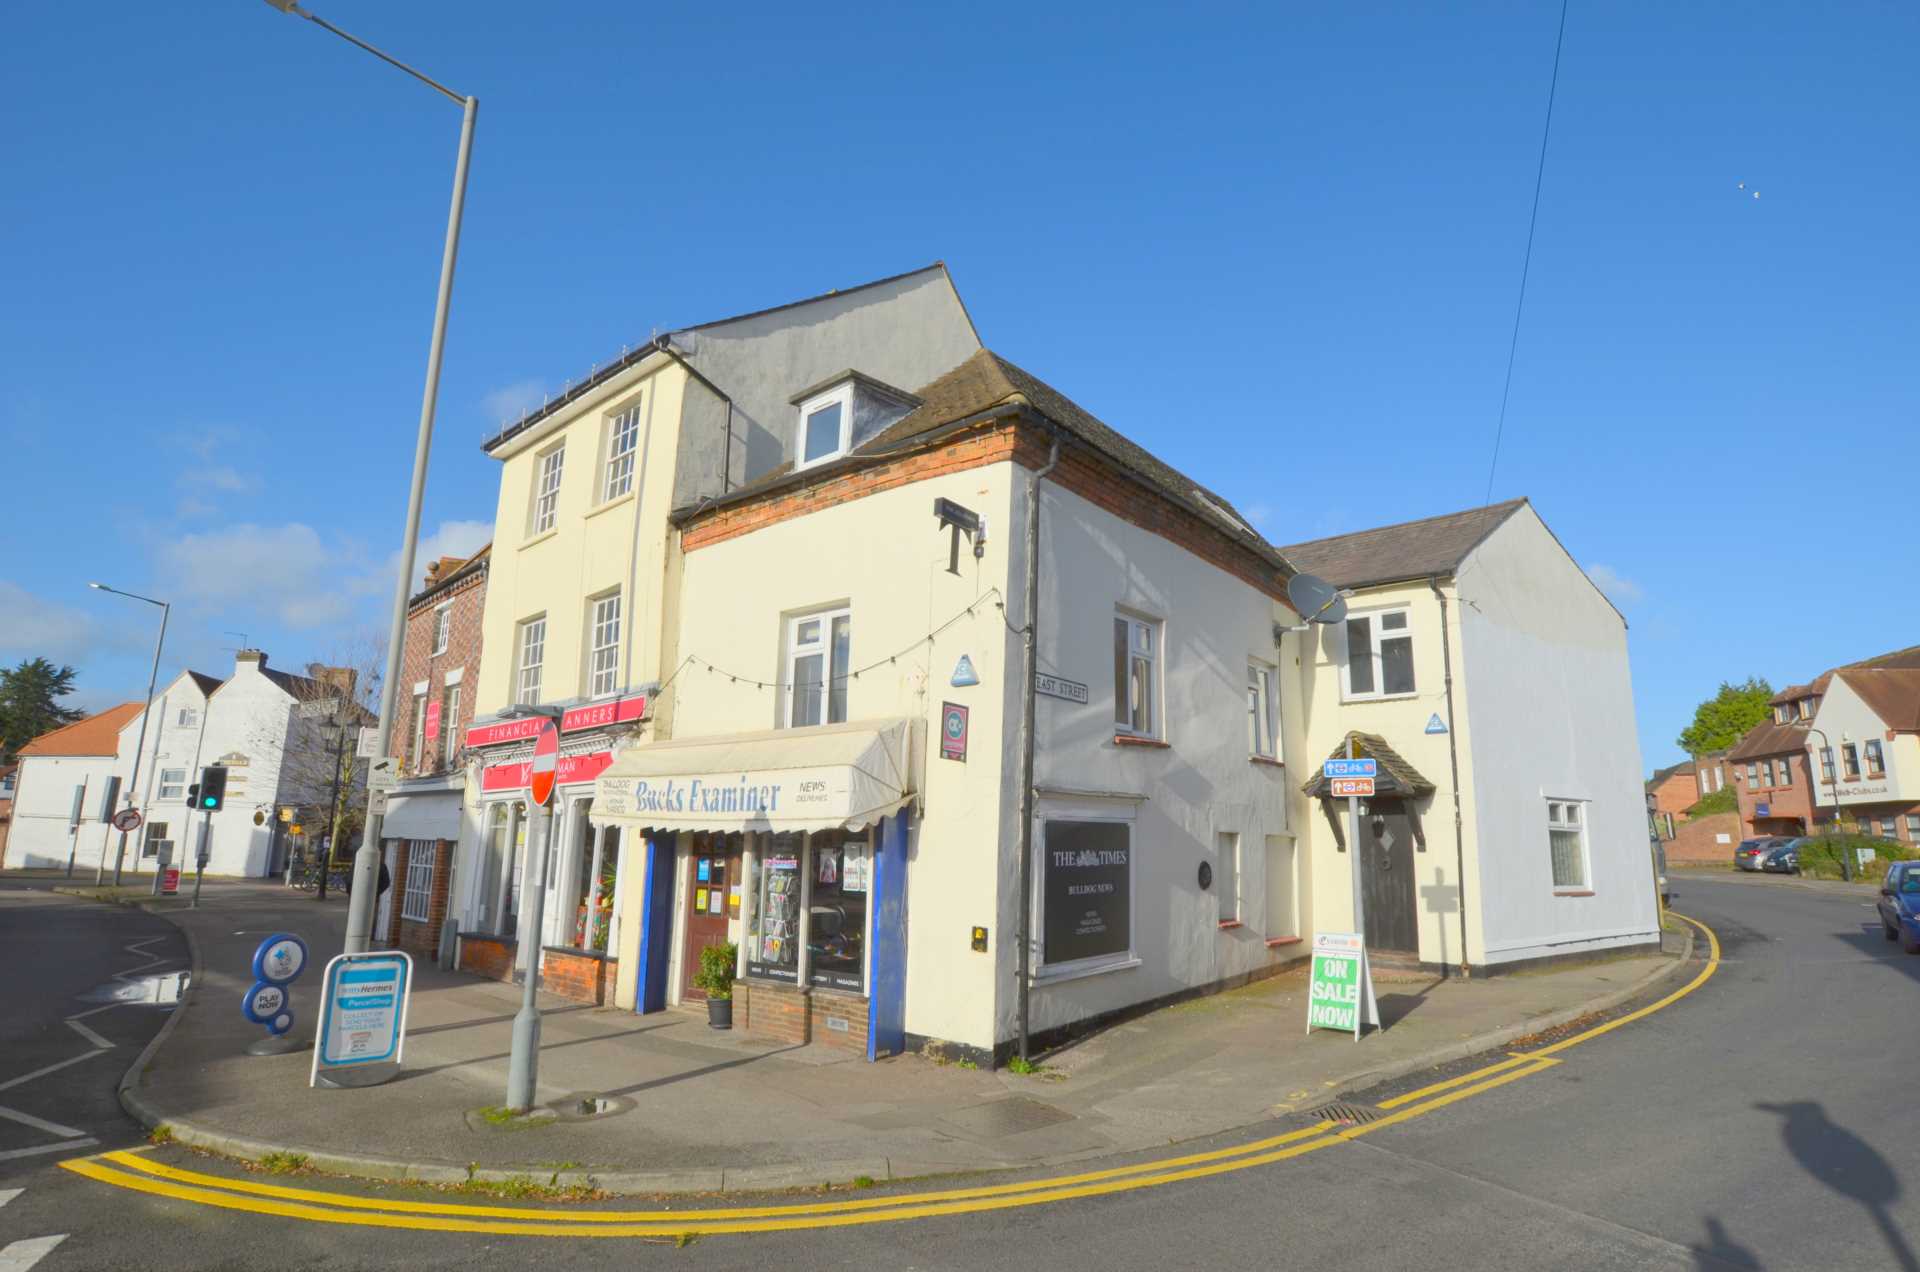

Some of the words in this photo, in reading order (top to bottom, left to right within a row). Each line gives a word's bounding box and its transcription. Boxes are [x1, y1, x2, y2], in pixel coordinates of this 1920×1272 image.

[1035, 676, 1056, 690] EAST
[1059, 683, 1086, 698] STREET
[565, 707, 613, 728] ANNERS
[636, 779, 684, 812] Bucks
[688, 775, 781, 812] Examiner
[799, 780, 826, 793] NEWS
[1053, 850, 1076, 867] THE
[1099, 849, 1127, 865] TIMES
[1323, 958, 1348, 978] ON
[259, 994, 280, 1002] PLAY
[1312, 980, 1357, 1004] SALE
[258, 1001, 279, 1010] NOW
[1312, 1004, 1354, 1028] NOW
